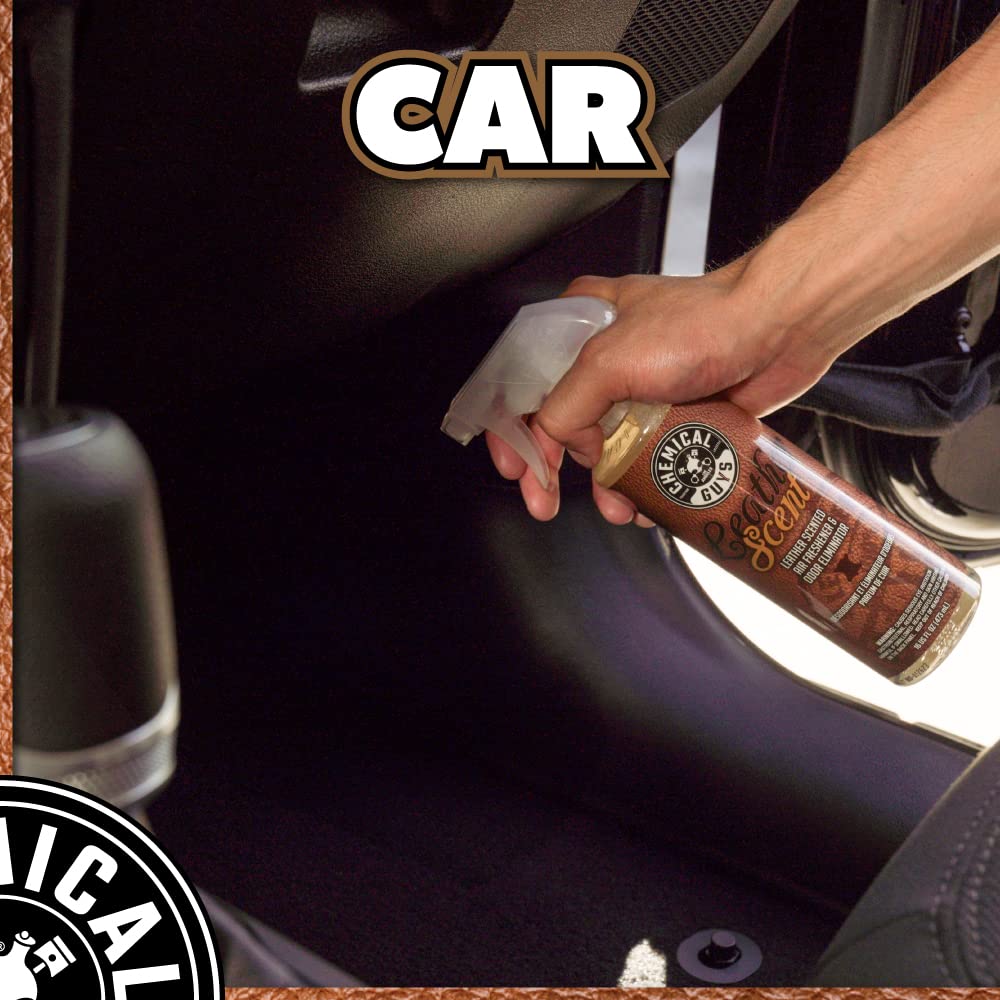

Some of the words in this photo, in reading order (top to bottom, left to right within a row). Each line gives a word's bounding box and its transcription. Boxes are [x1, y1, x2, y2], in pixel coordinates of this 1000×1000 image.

[659, 430, 711, 498] CHEMICAL
[701, 462, 732, 501] GUYS
[703, 442, 788, 560] Leath
[744, 471, 810, 572] Scent
[779, 537, 807, 570] LEATHER
[798, 508, 828, 542] SCENTED
[792, 559, 808, 576] AIR
[800, 521, 835, 564] FRESHENER
[826, 515, 837, 525] &
[802, 561, 823, 585] ODOR
[815, 522, 851, 566] ELIMINATOR
[855, 585, 865, 594] ET
[858, 583, 878, 607] PARFUM
[872, 577, 882, 587] DE
[876, 564, 891, 580] CUIR
[917, 635, 927, 645] US
[927, 623, 936, 632] OZ
